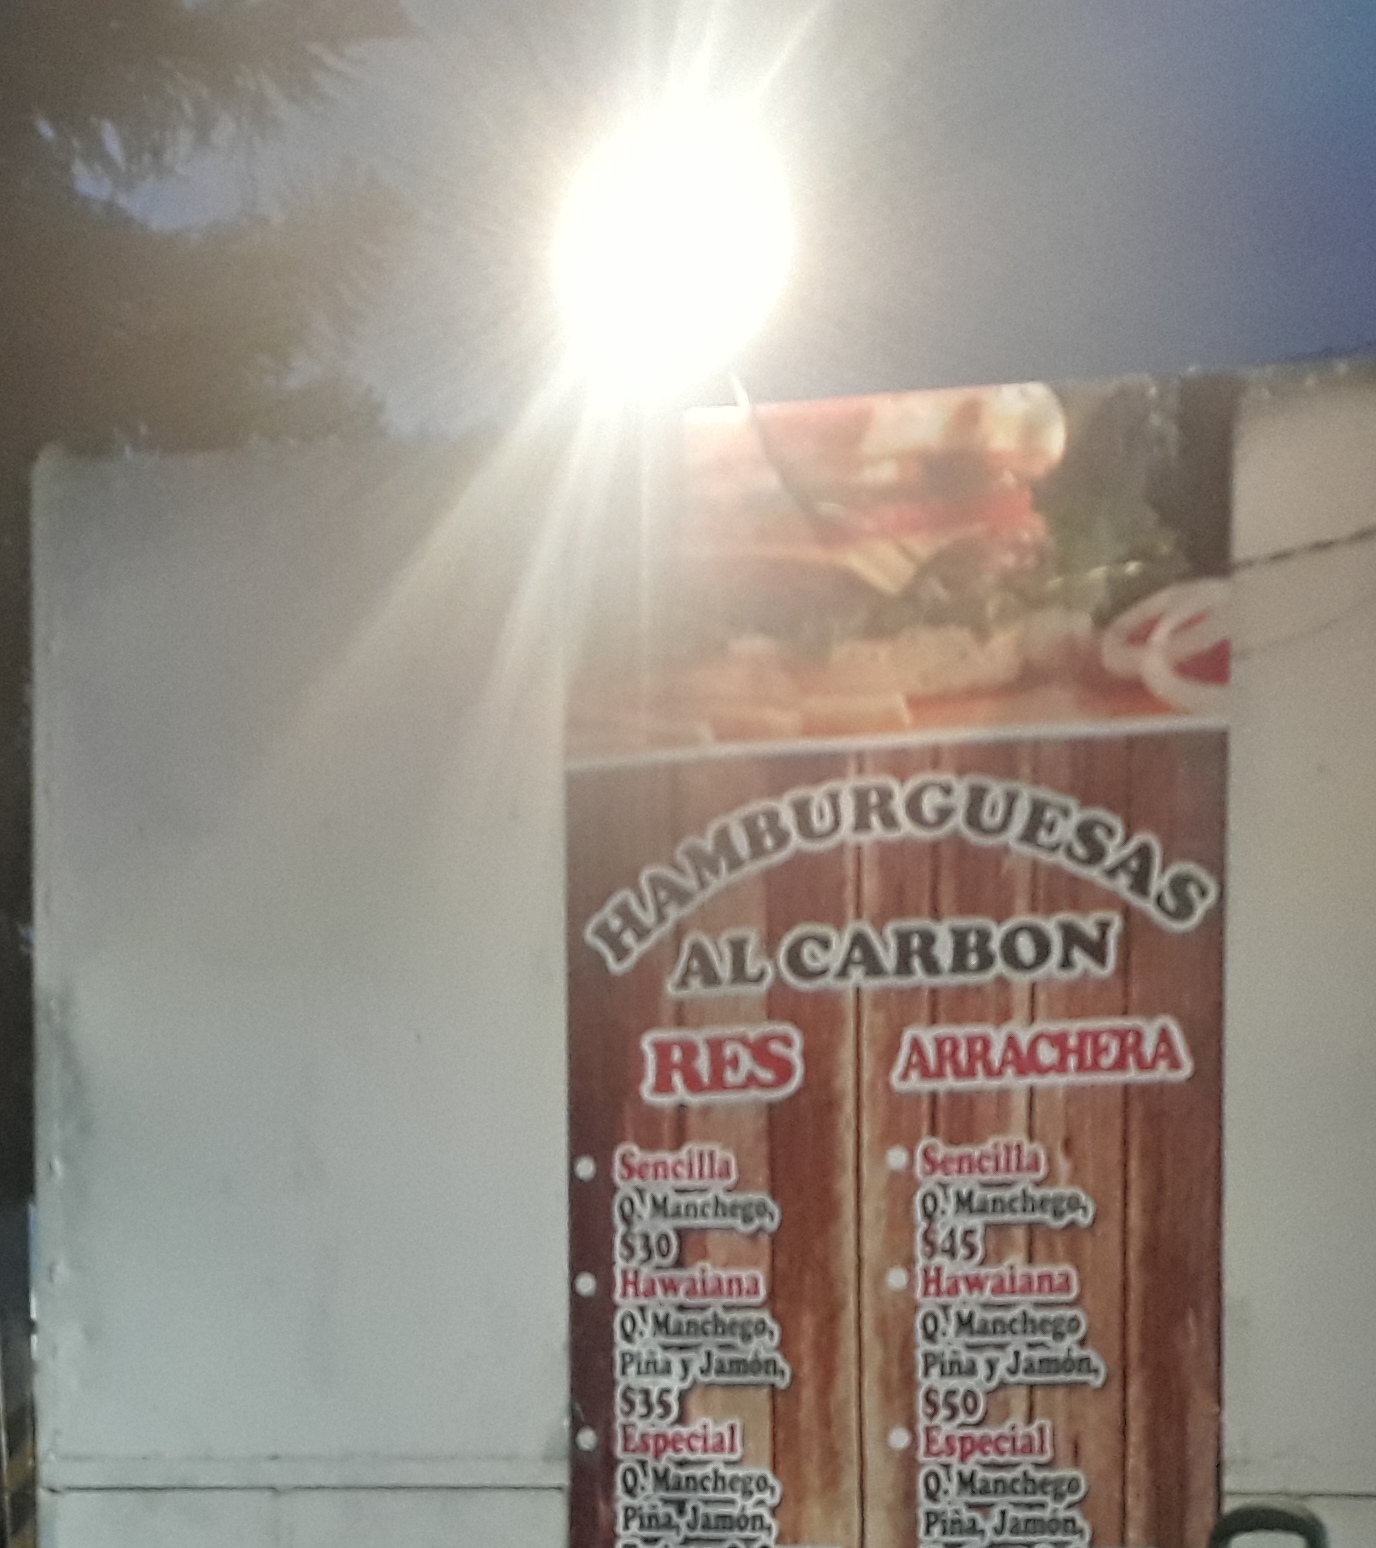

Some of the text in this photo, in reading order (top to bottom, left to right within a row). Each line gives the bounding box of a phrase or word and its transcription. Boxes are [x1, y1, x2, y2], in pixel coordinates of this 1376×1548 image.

[586, 773, 1220, 972] HAMBURGUESAS
[672, 914, 1118, 990] AL CARBON
[646, 1032, 798, 1096] RES
[896, 1022, 1188, 1082] ARRACHERA
[620, 1149, 734, 1181] Sencilla
[923, 1141, 1041, 1175] Sencilla
[619, 1231, 673, 1265] $30
[922, 1226, 977, 1261] $45
[621, 1266, 761, 1299] Hawaiana
[923, 1264, 1072, 1298] Hawaiana
[620, 1349, 672, 1377] Piña
[677, 1352, 691, 1382] y
[923, 1350, 978, 1379] Piña
[983, 1355, 998, 1383] y
[620, 1386, 675, 1421] $35
[923, 1388, 979, 1422] $50
[621, 1423, 739, 1460] Especial
[924, 1422, 1052, 1462] Especial
